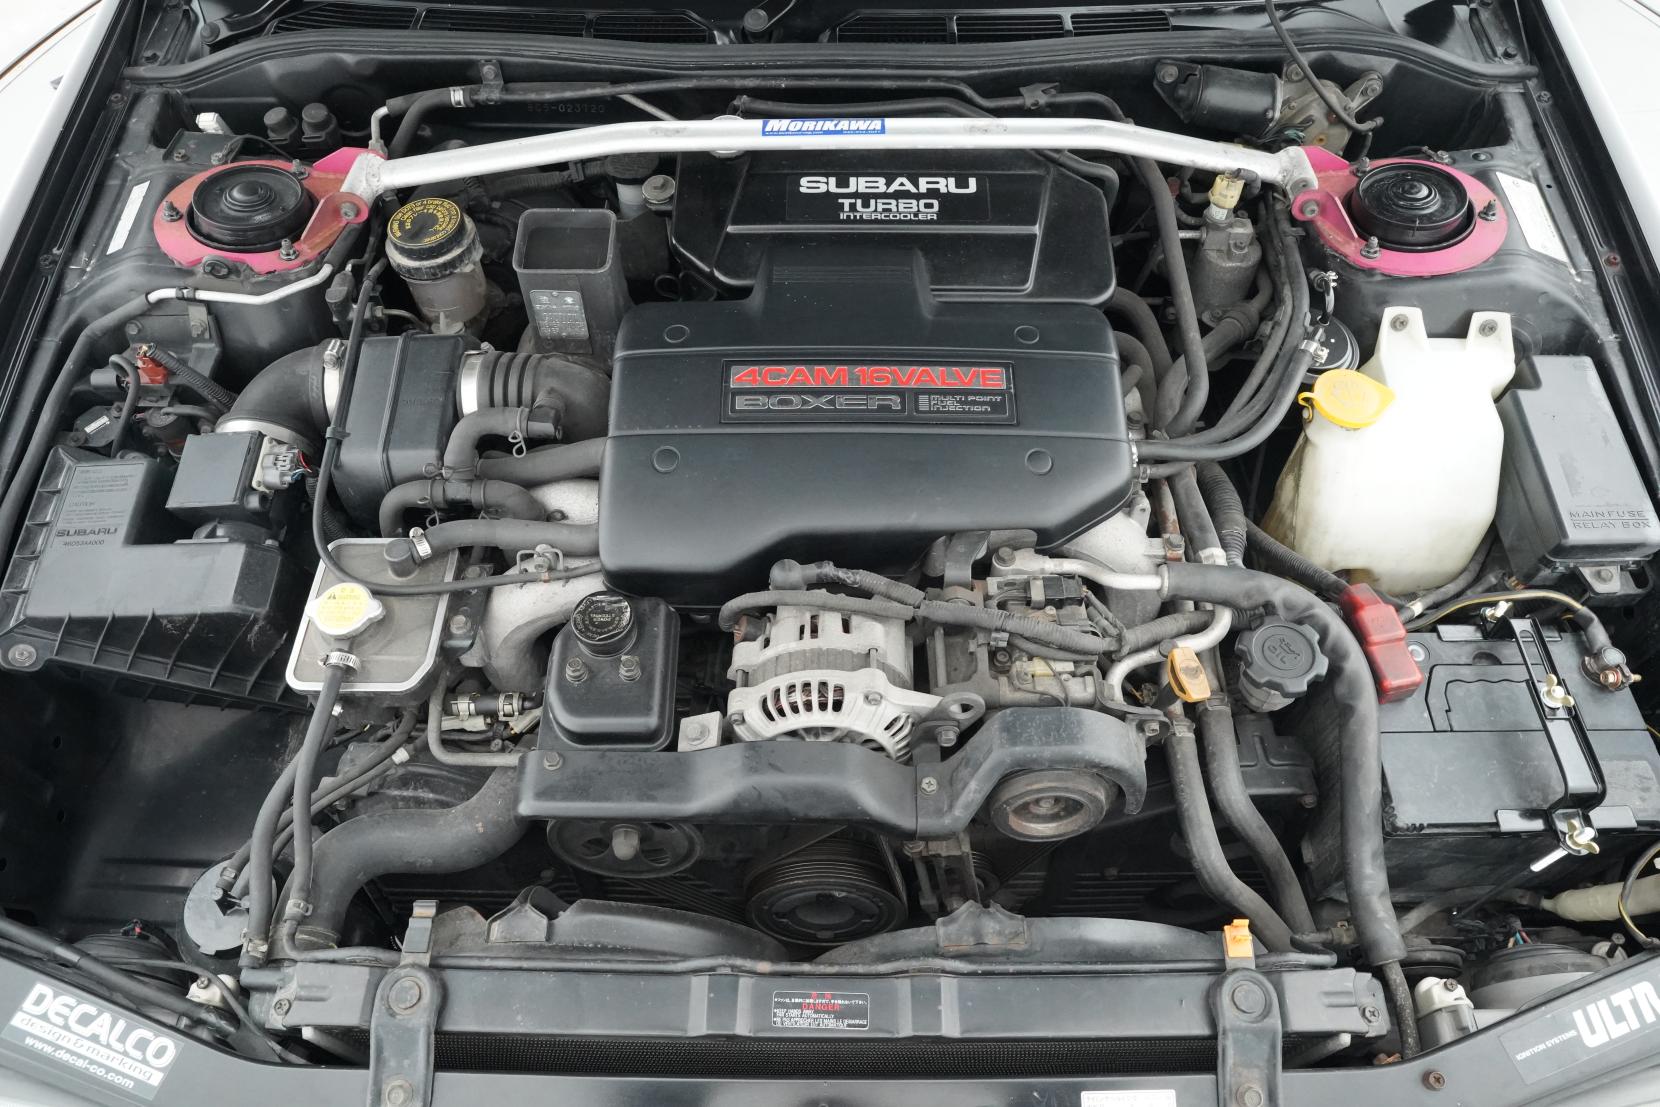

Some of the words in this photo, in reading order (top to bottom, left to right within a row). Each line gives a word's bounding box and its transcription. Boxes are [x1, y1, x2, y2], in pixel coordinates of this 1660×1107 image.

[764, 119, 882, 132] MORIKAWA
[799, 176, 977, 194] SUBARU
[838, 198, 939, 212] TURBO
[839, 212, 938, 220] INTERCOOLER
[734, 366, 849, 386] 4CAM
[853, 366, 1005, 388] 16VALVE
[735, 395, 902, 410] BOXER
[1572, 520, 1616, 529] RELAY
[1621, 520, 1652, 529] BOX
[55, 527, 118, 537] SUBARU
[1267, 645, 1286, 665] OIL
[802, 1003, 841, 1011] DANGER
[22, 983, 176, 1068] DECALCO
[24, 1035, 135, 1089] www.decal-co.com
